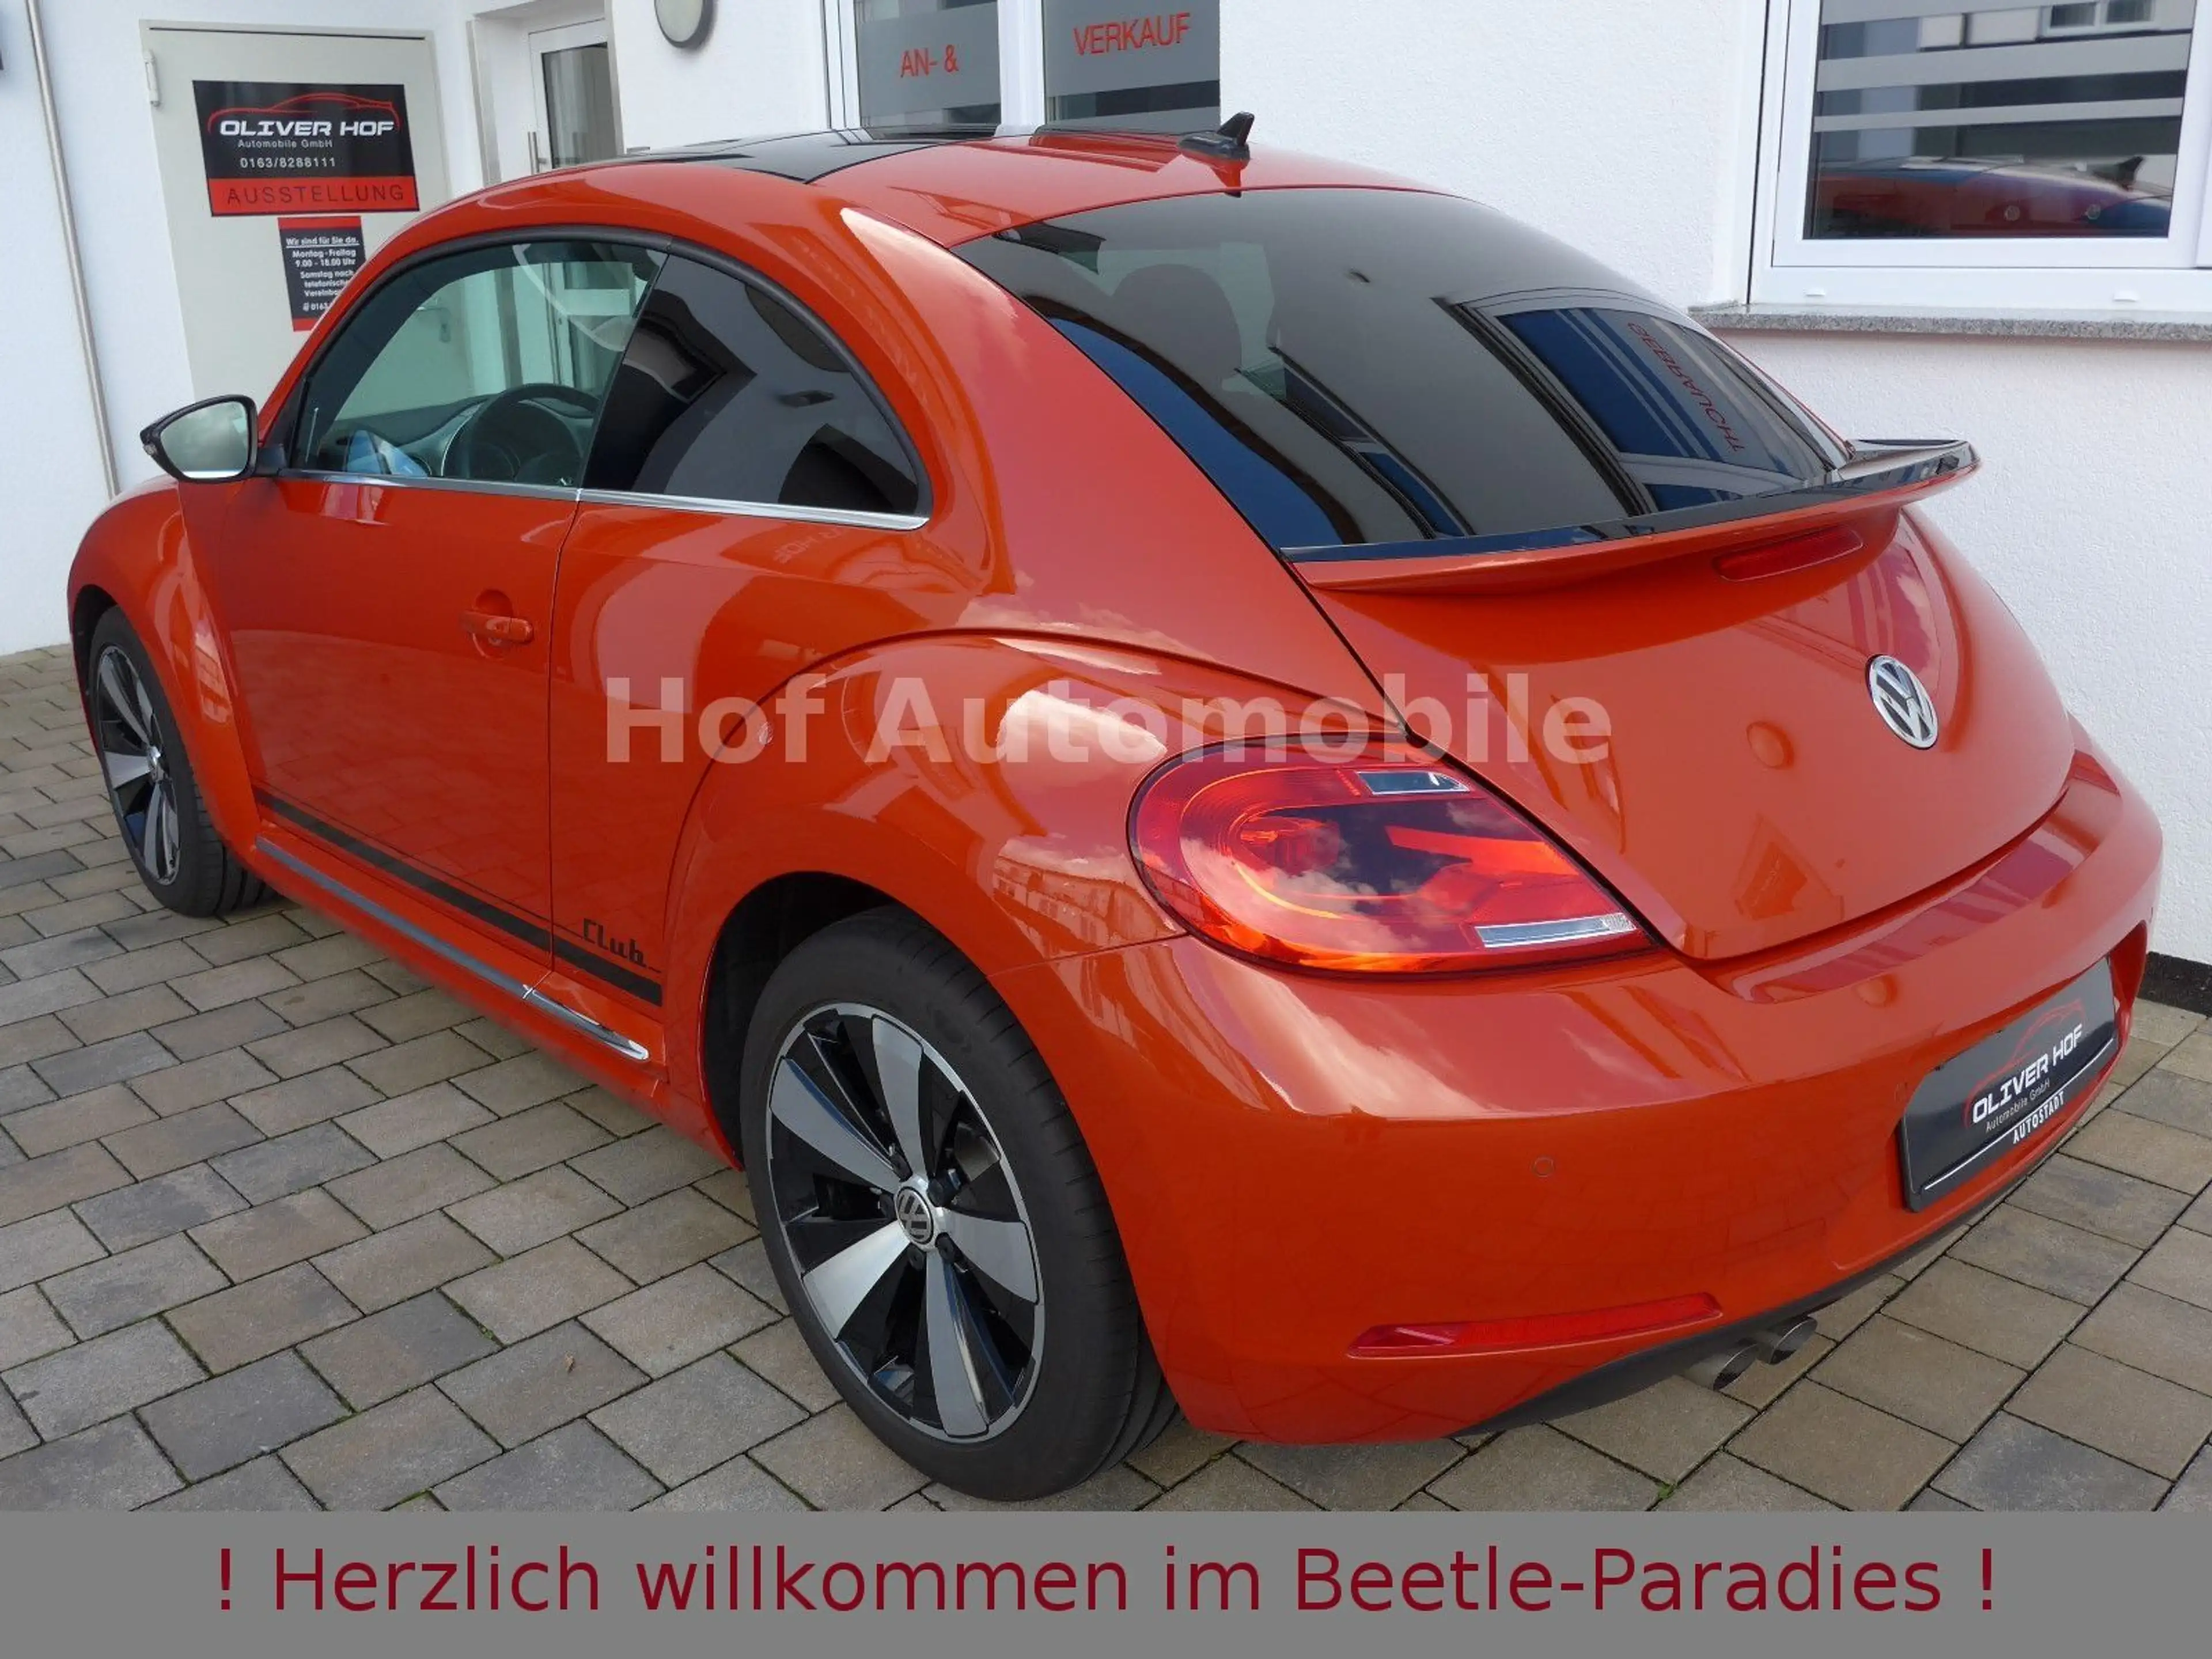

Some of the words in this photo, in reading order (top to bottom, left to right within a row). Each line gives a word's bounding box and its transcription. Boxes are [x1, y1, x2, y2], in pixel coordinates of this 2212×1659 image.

[1073, 13, 1191, 55] VERKAUF
[900, 48, 937, 78] AN-
[944, 44, 960, 73] &
[219, 120, 332, 137] OLIVER
[339, 120, 394, 136] HOF
[237, 139, 297, 148] Automobile
[301, 139, 333, 148] GmbH
[240, 157, 336, 168] 0163/8288111
[227, 184, 404, 205] AUSSTELLUNG
[286, 237, 299, 245] Wir
[301, 237, 317, 245] sind
[319, 236, 329, 244] für
[331, 236, 344, 244] Sie
[291, 250, 324, 259] Montag
[329, 249, 356, 257] Freitag
[300, 271, 334, 279] Samstag
[583, 918, 647, 968] Club
[1972, 1053, 2049, 1124] OLIVER
[2052, 1023, 2082, 1066] HOF
[1986, 1097, 2028, 1133] Automobile
[2029, 1078, 2050, 1101] GmbH
[2013, 1090, 2064, 1145] AUTOSTADT
